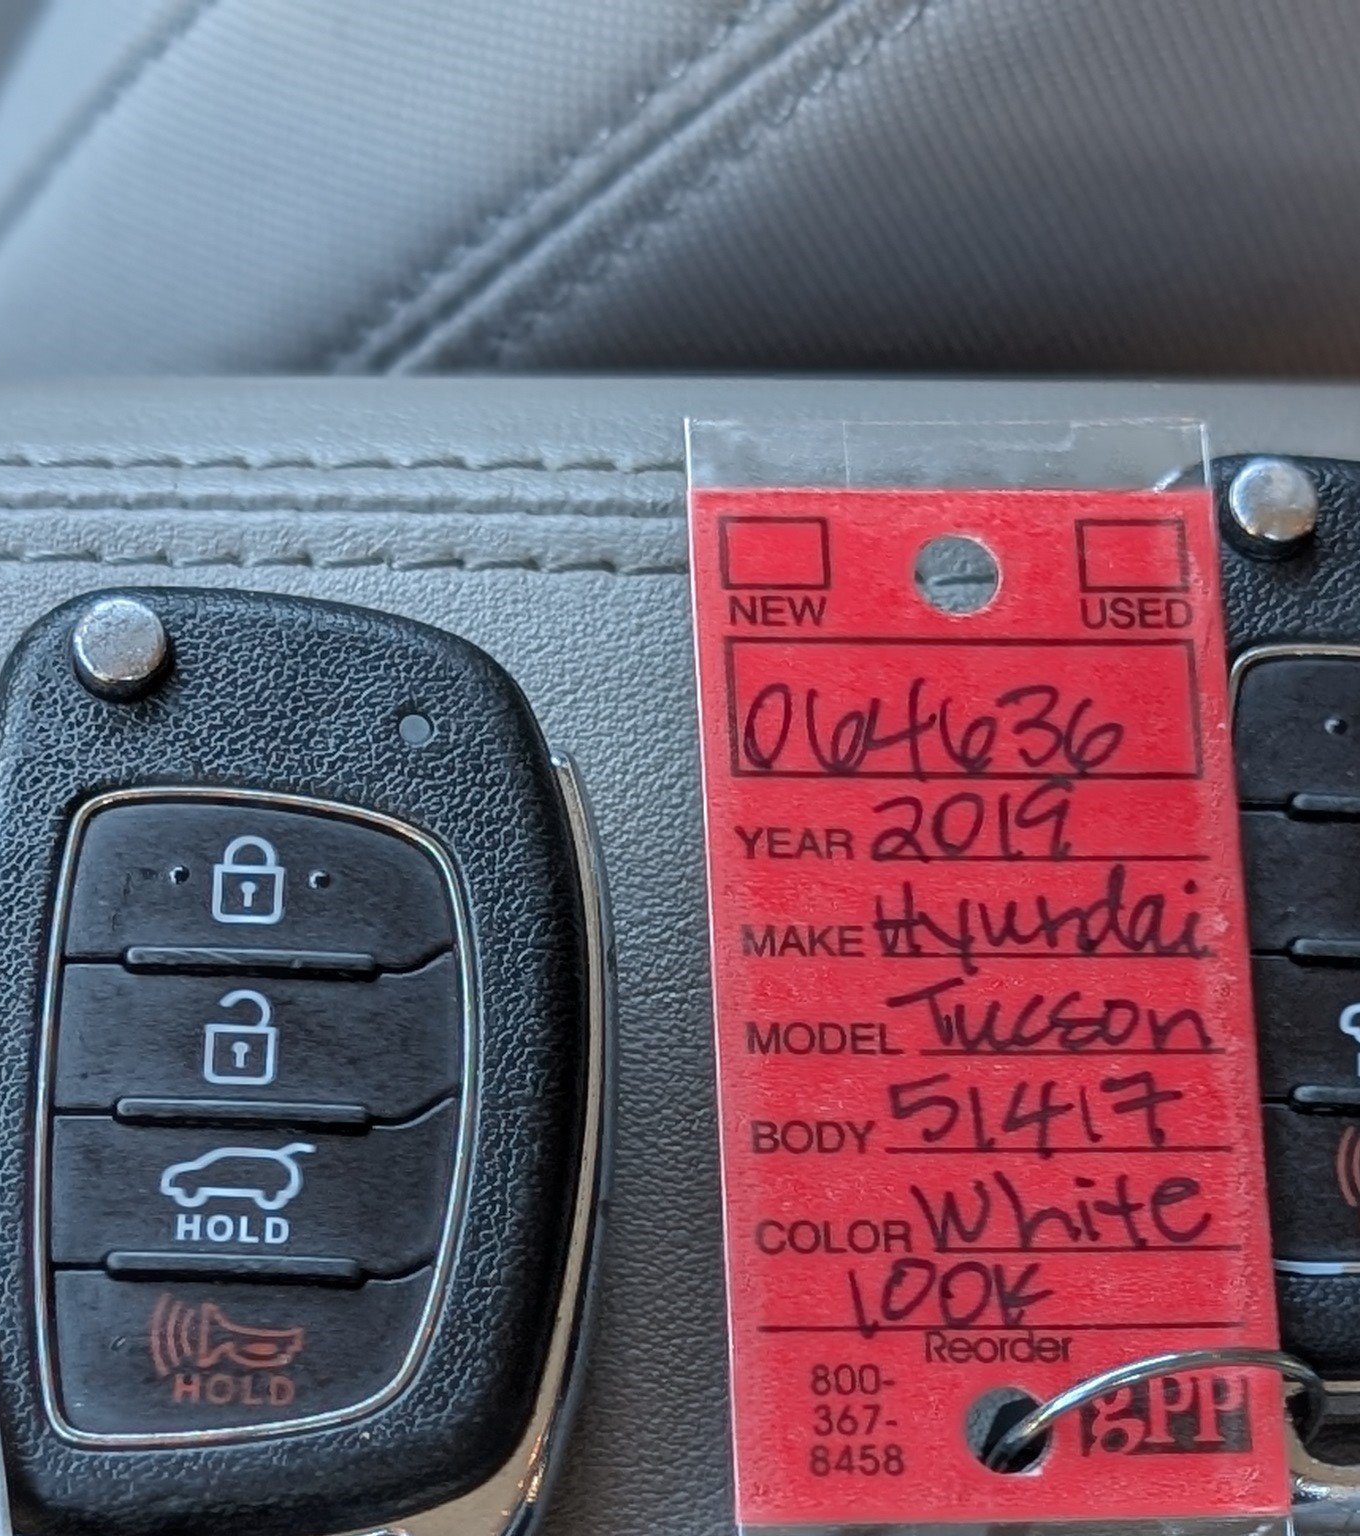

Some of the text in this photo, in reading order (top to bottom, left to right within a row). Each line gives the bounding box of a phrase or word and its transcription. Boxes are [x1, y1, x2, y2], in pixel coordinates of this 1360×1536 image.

[729, 597, 827, 627] NEW
[1080, 598, 1194, 630] USED
[743, 677, 1125, 782] 064636
[871, 776, 1076, 862] 2019
[734, 827, 854, 860] YEAR
[874, 864, 1210, 975] Hyundai
[743, 925, 865, 958] MAKE
[886, 978, 1212, 1051] Tucson
[746, 1022, 904, 1055] MODEL
[889, 1072, 1182, 1158] 51417
[750, 1120, 876, 1154] BODY
[911, 1170, 1212, 1250] White
[175, 1213, 291, 1244] HOLD
[755, 1219, 913, 1254] COLOR
[925, 1332, 1073, 1364] Reorder
[171, 1373, 297, 1406] HOLD
[810, 1363, 895, 1394] 800-
[813, 1404, 898, 1436] 367-
[810, 1443, 905, 1477] 8458
